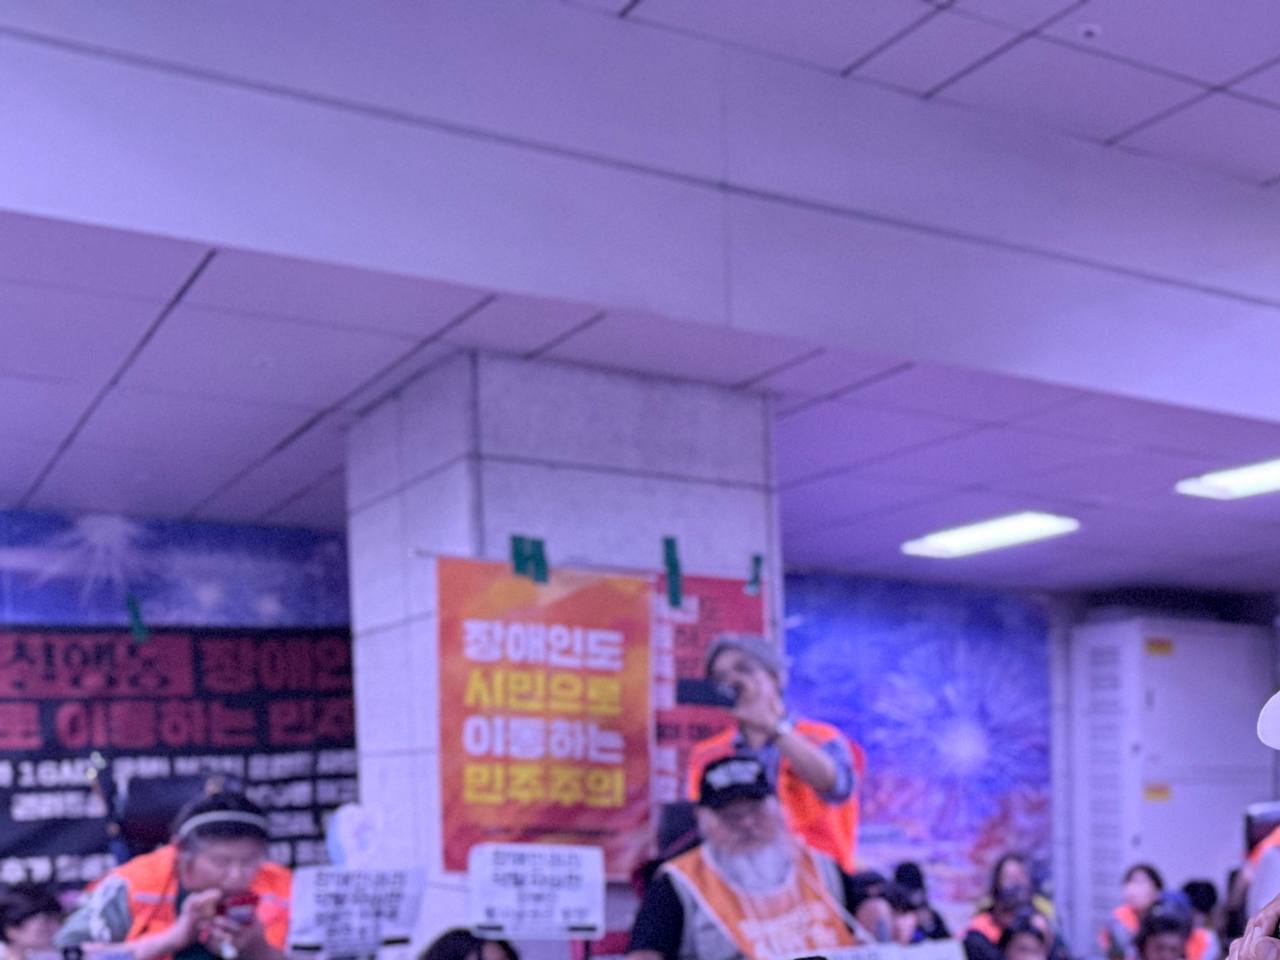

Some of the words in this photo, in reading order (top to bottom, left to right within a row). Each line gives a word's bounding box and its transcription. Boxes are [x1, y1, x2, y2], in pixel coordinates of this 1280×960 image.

[462, 619, 624, 671] 장애인도
[464, 669, 623, 717] 시민으로
[462, 715, 625, 764] 이동하는
[462, 764, 626, 809] 민주주의
